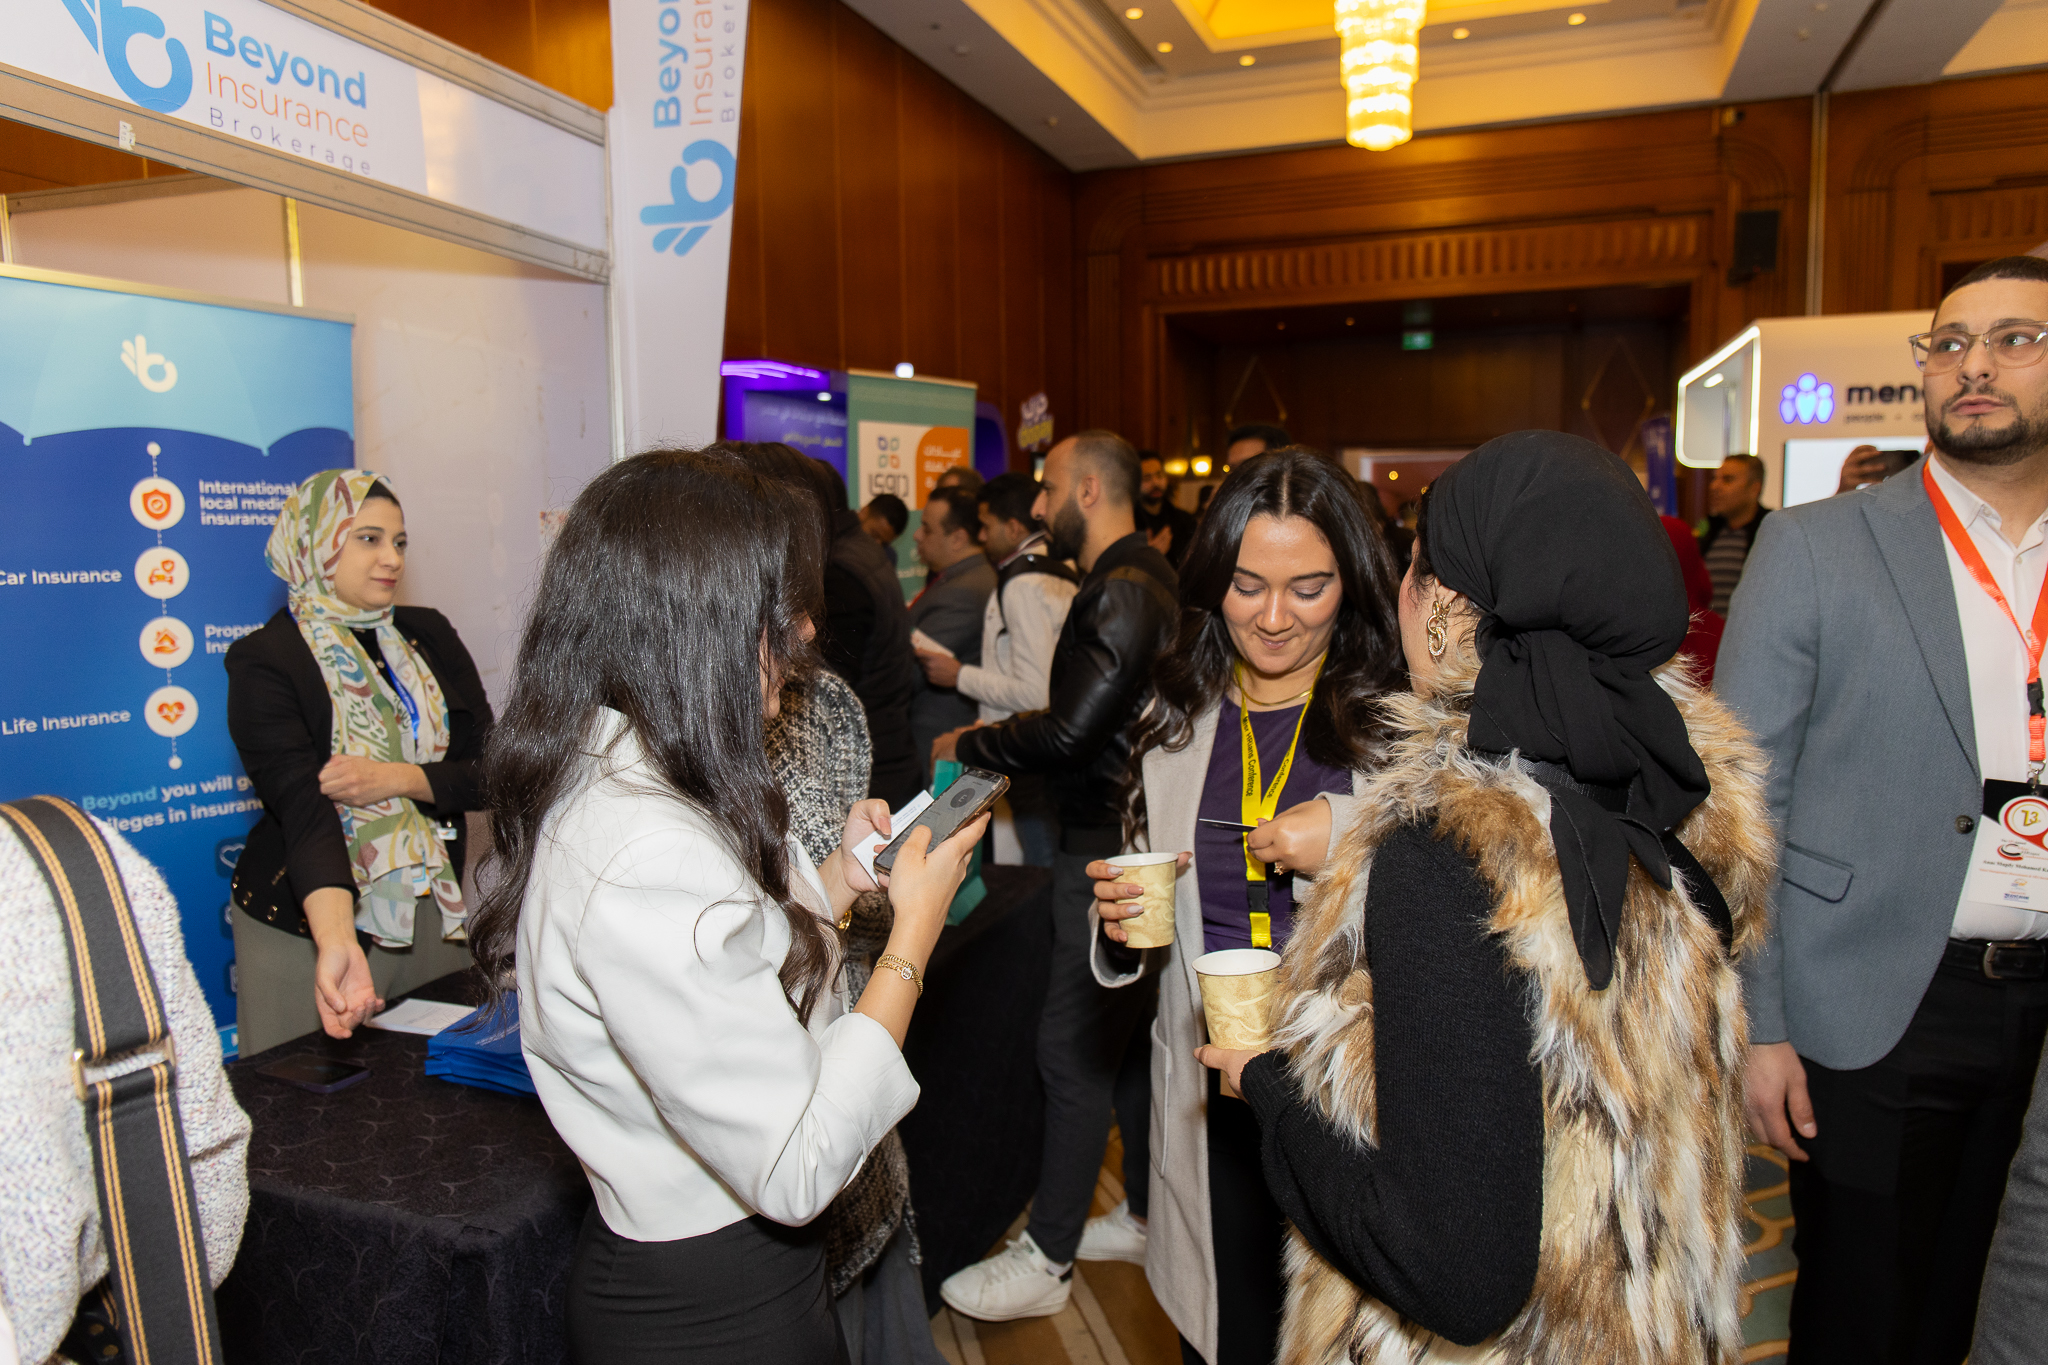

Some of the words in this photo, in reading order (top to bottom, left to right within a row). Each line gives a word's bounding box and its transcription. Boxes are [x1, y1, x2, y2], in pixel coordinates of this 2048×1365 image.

[204, 10, 367, 109] Beyond
[207, 62, 369, 147] Insurance
[210, 107, 371, 175] Brokerage
[1846, 385, 1925, 404] men
[198, 478, 297, 496] International
[199, 495, 239, 510] local
[200, 510, 277, 526] insurance
[0, 570, 27, 586] Car
[32, 568, 123, 585] Insurance
[2, 717, 38, 735] Life
[42, 709, 132, 732] Insurance
[1245, 759, 1257, 797] Conference
[82, 785, 158, 811] Beyond
[161, 783, 198, 803] you
[200, 775, 233, 794] will
[168, 807, 188, 824] in
